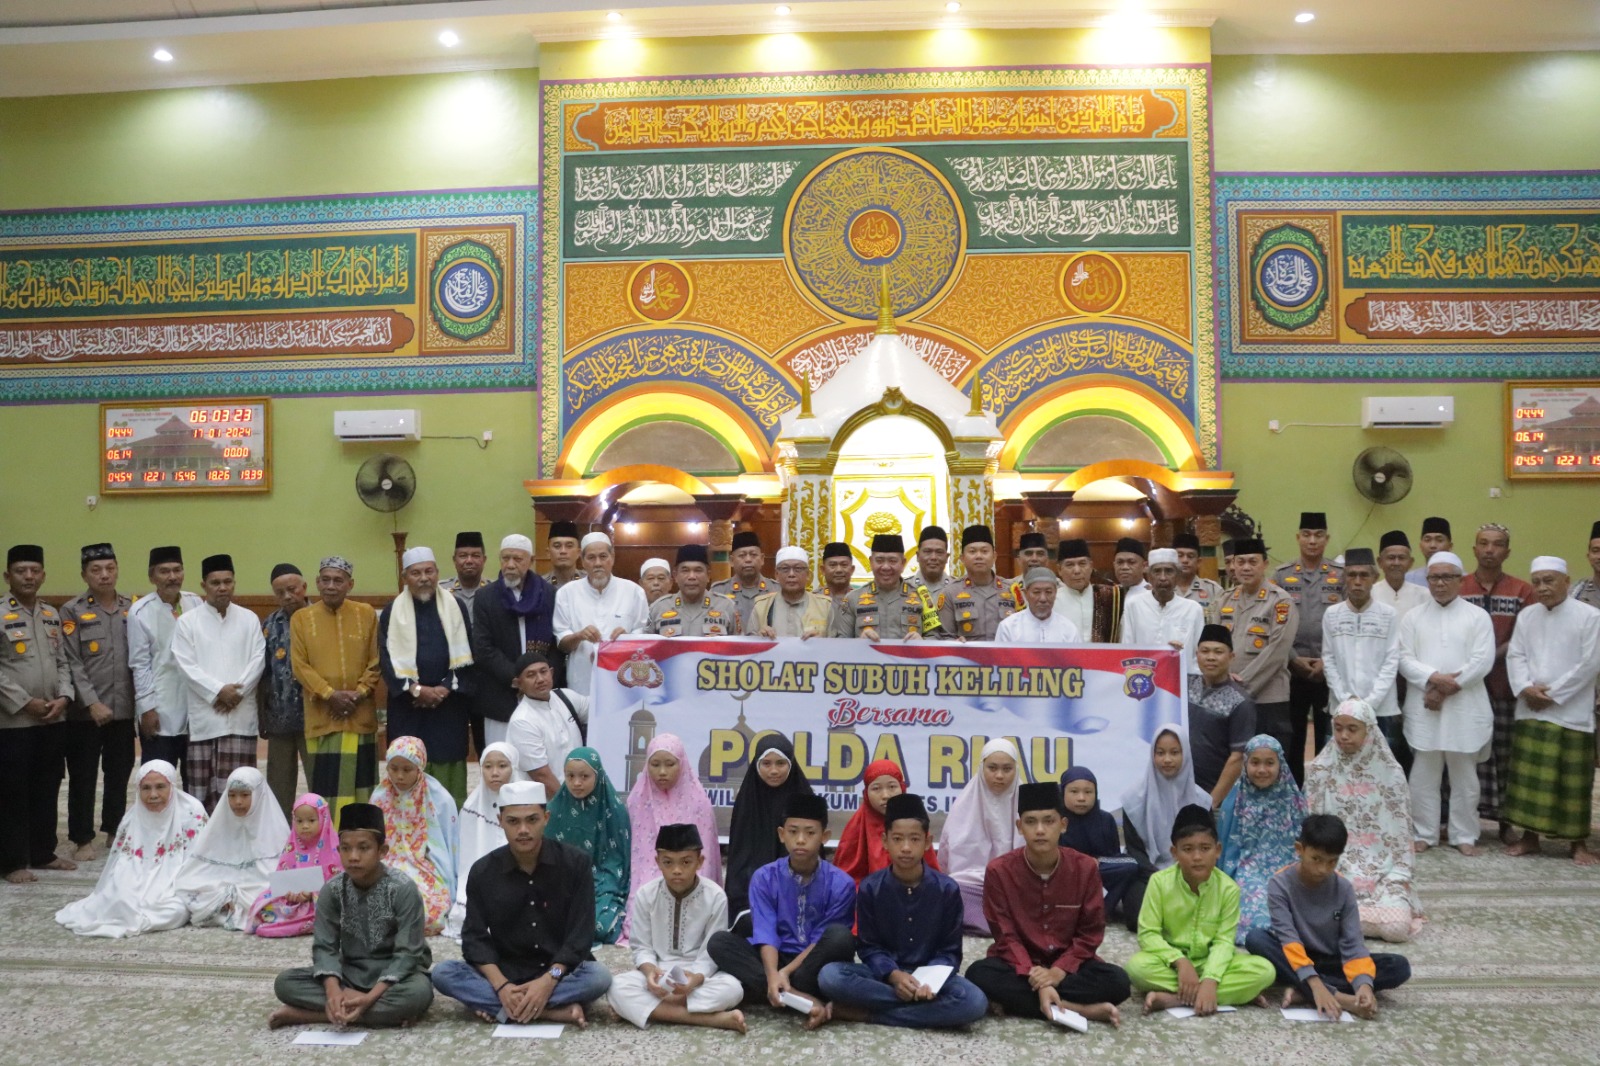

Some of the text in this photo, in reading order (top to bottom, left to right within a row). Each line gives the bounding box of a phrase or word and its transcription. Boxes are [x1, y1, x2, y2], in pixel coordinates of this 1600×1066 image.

[697, 659, 1084, 698] SHOLAT SUBUH KELILING
[828, 697, 953, 727] Bersama
